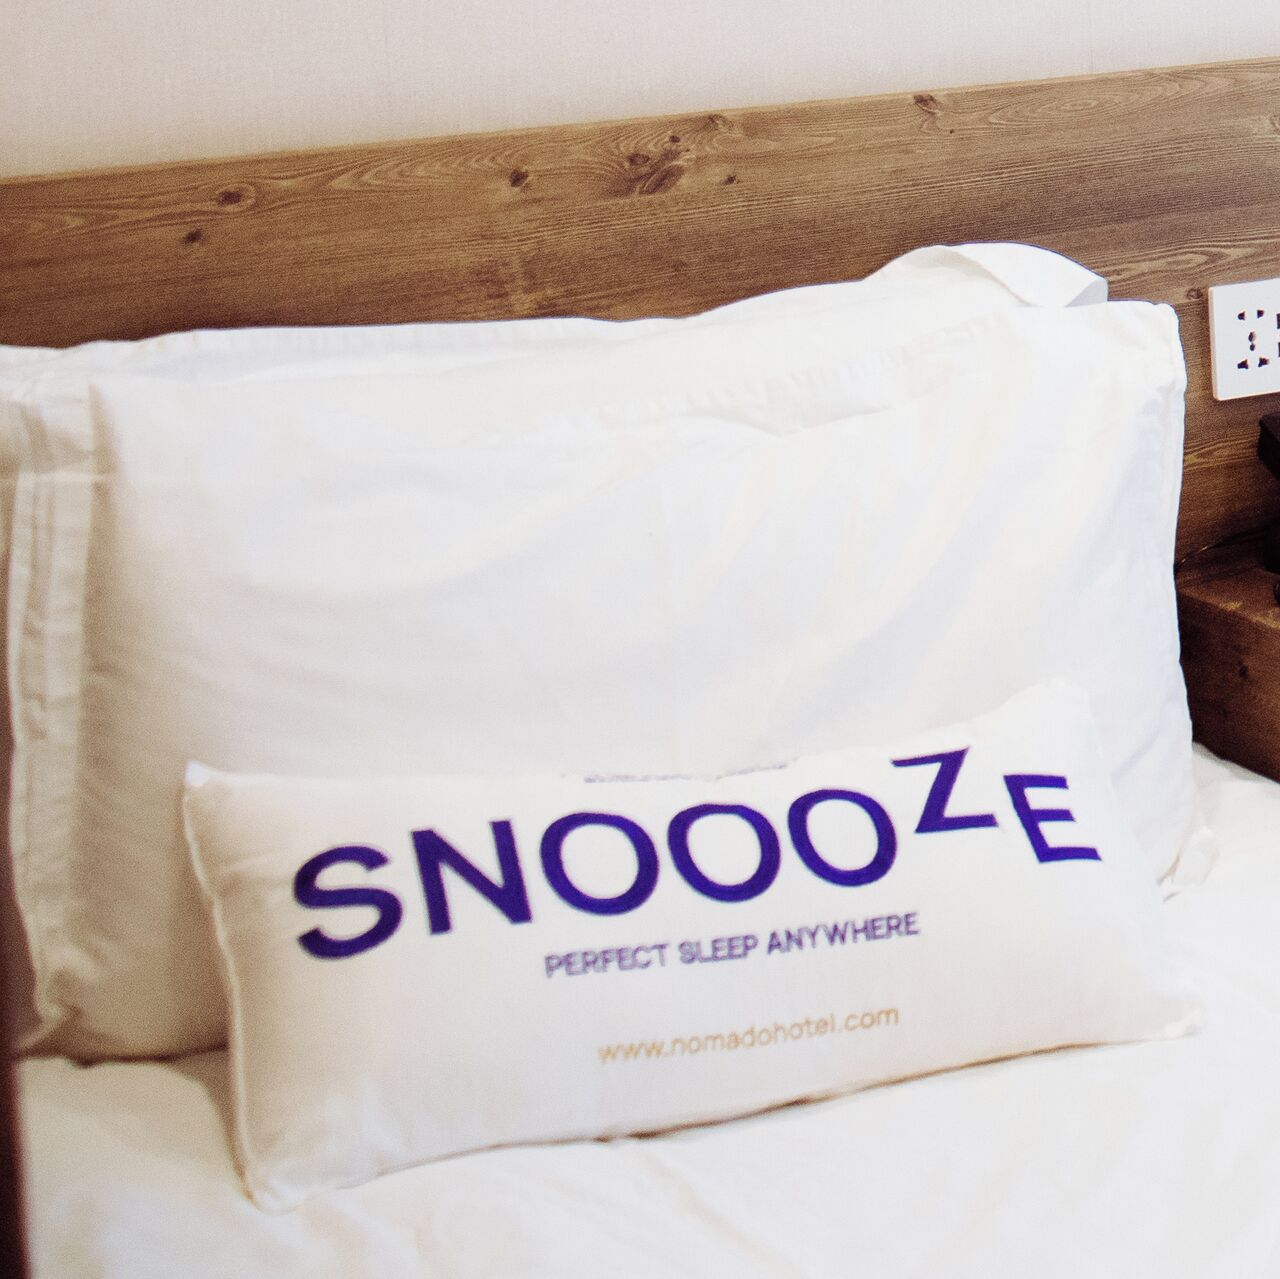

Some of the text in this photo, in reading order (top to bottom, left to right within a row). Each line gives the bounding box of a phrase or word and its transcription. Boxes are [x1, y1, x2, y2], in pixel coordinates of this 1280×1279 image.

[292, 747, 1102, 961] SNOOOZE
[544, 911, 921, 979] PERFECT SLEEP ANYWHERE
[597, 1006, 900, 1065] www.nomadohotel.com
